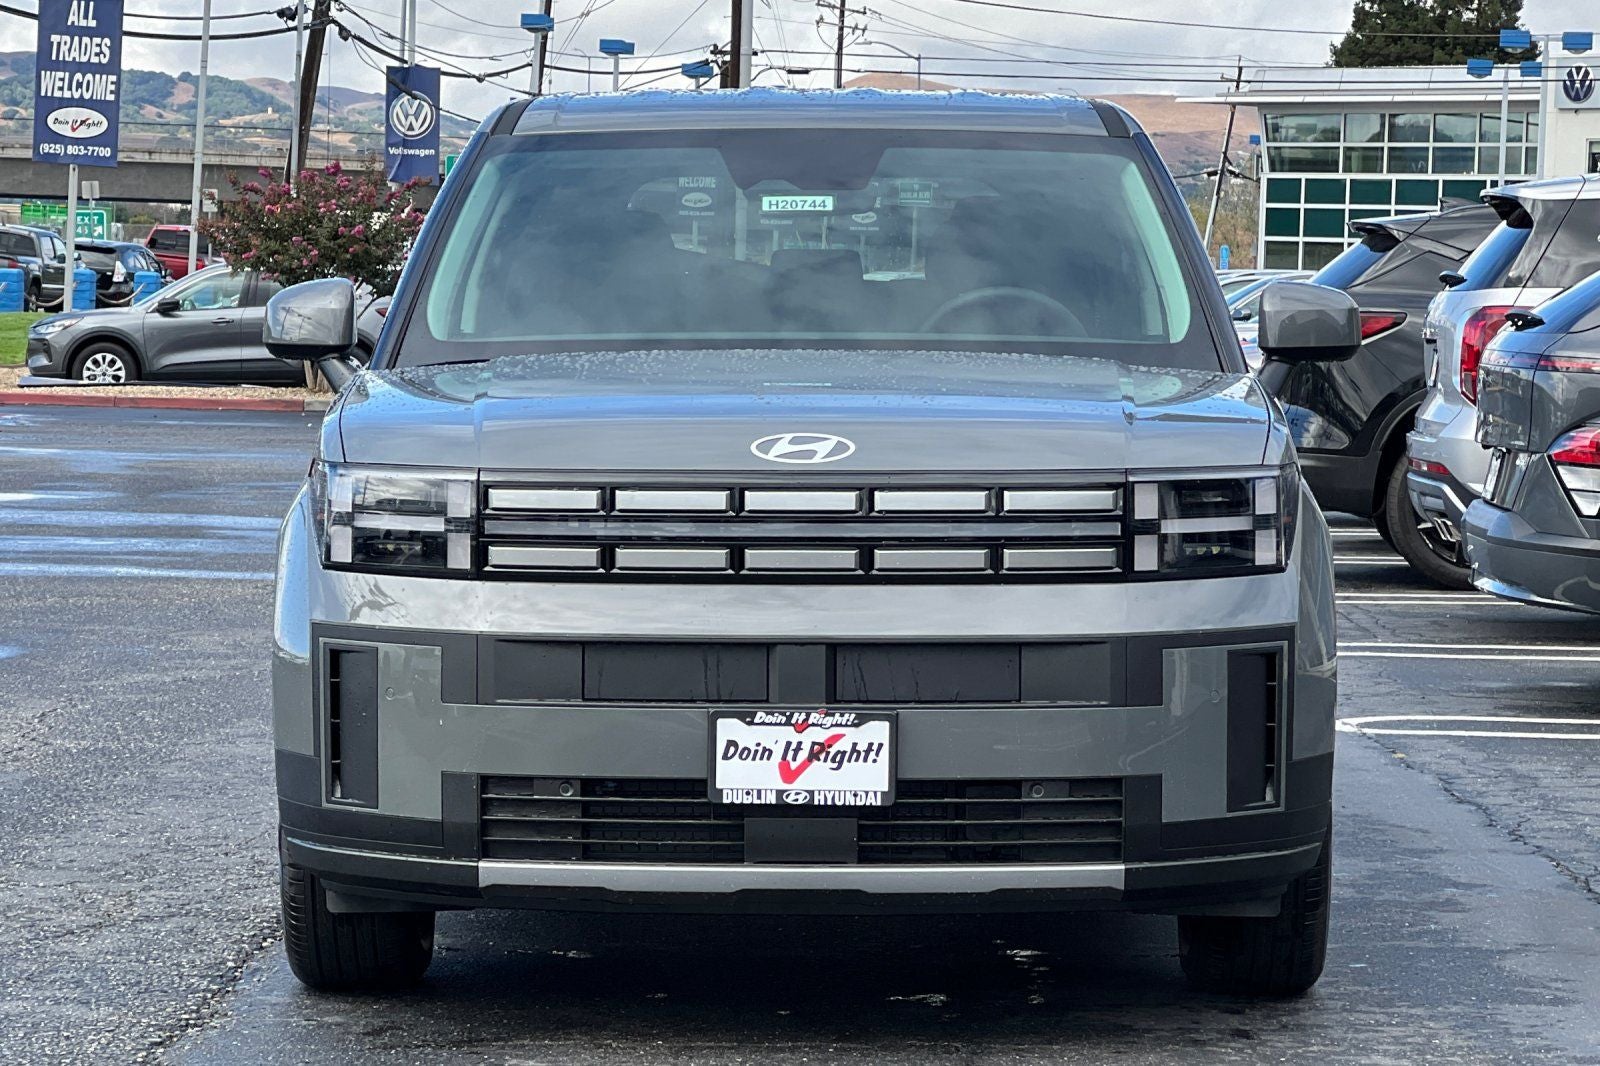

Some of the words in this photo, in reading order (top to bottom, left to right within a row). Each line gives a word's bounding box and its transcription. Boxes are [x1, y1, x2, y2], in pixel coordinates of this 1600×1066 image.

[67, 0, 97, 27] ALL
[50, 34, 111, 64] TRADES
[40, 70, 117, 101] WELCOME
[40, 143, 65, 156] (925)
[66, 145, 111, 157] 803-7700
[678, 176, 716, 188] WELCOME
[768, 199, 828, 210] H20744
[76, 215, 99, 224] EXT
[753, 711, 789, 724] Doin'
[791, 711, 807, 724] It
[721, 739, 778, 762] Doin'
[780, 740, 804, 762] It
[807, 741, 884, 771] Right!
[722, 789, 777, 804] DUBLIN
[813, 790, 882, 806] HYUNDAI
